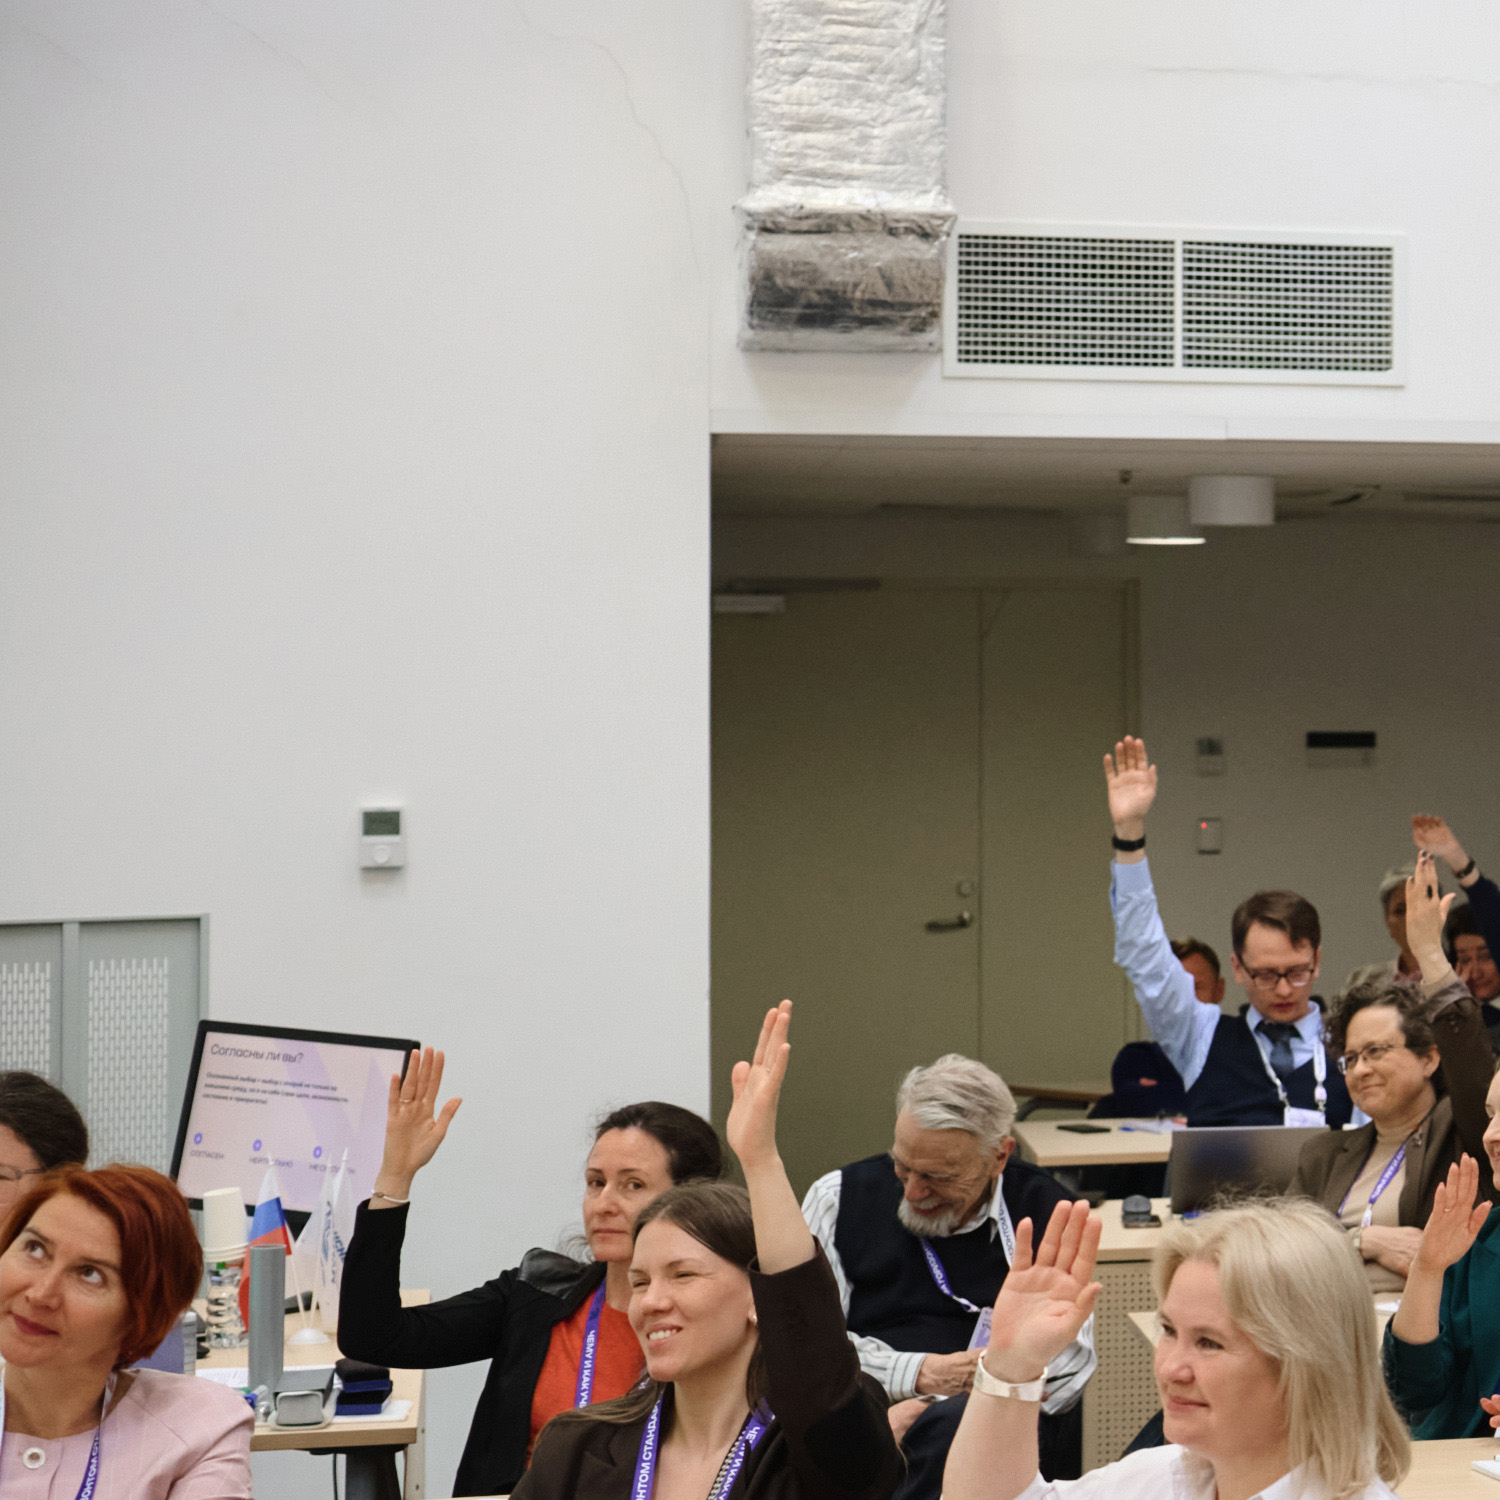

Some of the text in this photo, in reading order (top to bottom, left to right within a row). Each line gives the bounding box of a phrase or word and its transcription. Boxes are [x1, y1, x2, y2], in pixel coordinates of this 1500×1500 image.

[210, 1043, 264, 1060] Согласны
[265, 1051, 281, 1062] ли
[585, 1329, 595, 1359] ЧЕМУ
[584, 1360, 592, 1369] И
[580, 1368, 592, 1391] КАК
[734, 1457, 744, 1467] И
[722, 1467, 738, 1492] КАК
